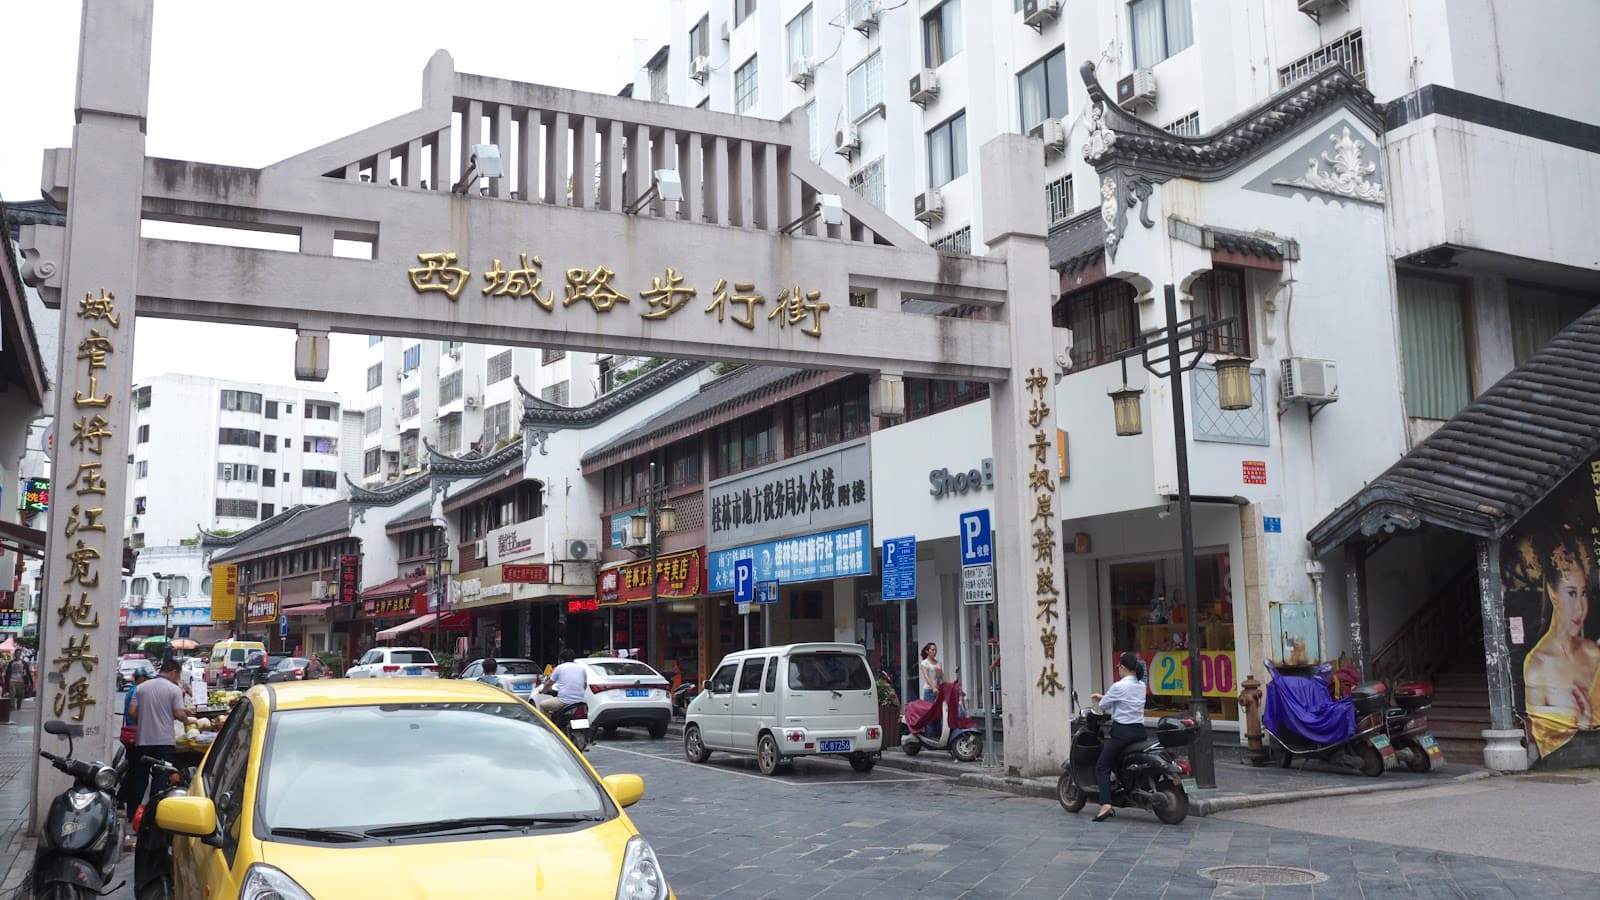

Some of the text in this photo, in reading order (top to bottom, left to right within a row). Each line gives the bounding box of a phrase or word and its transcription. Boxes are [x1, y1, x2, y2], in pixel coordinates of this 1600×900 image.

[408, 251, 830, 338] 西城路步行街
[53, 287, 120, 722] 城窄山将压江宽地共浮
[711, 467, 835, 533] 桂林市地方税务局办公楼
[886, 543, 896, 564] P
[963, 515, 982, 559] P
[737, 565, 749, 596] P
[1161, 656, 1176, 690] 2
